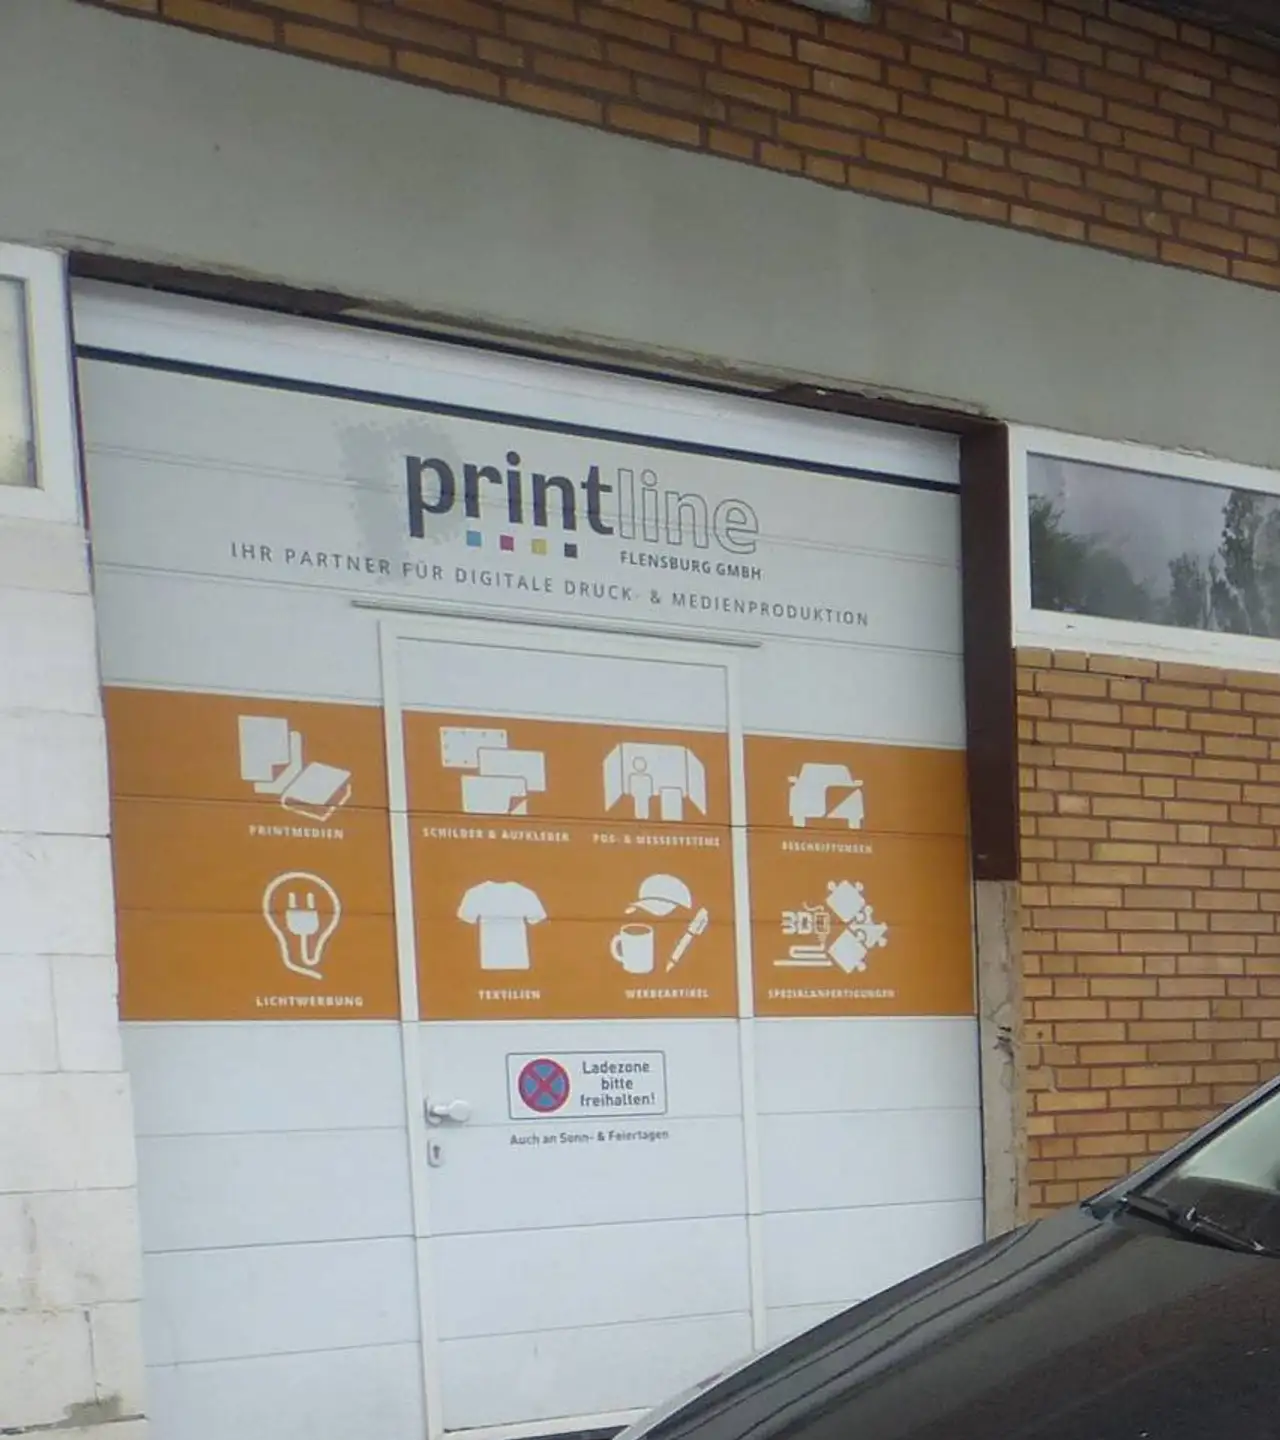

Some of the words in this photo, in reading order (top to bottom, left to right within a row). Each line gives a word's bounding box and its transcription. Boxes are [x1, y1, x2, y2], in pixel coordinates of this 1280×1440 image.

[405, 450, 760, 555] printline
[619, 550, 712, 575] FLENSBURG
[716, 561, 762, 581] GMBH
[231, 541, 273, 563] IHR
[284, 547, 391, 576] PARTNER
[402, 560, 444, 581] FÜR
[455, 566, 553, 593] DIGITALE
[650, 589, 661, 605] &
[671, 591, 869, 628] MEDIENPRODUKTION
[248, 824, 345, 840] PRINTMEDIEN
[255, 995, 364, 1008] LICHTWERBUNG
[581, 1060, 651, 1075] Ladezone
[601, 1077, 634, 1091] bitte
[580, 1092, 656, 1108] freihalten!
[509, 1133, 540, 1146] Auch
[542, 1134, 557, 1145] an
[608, 1129, 670, 1143] Feiertagen
